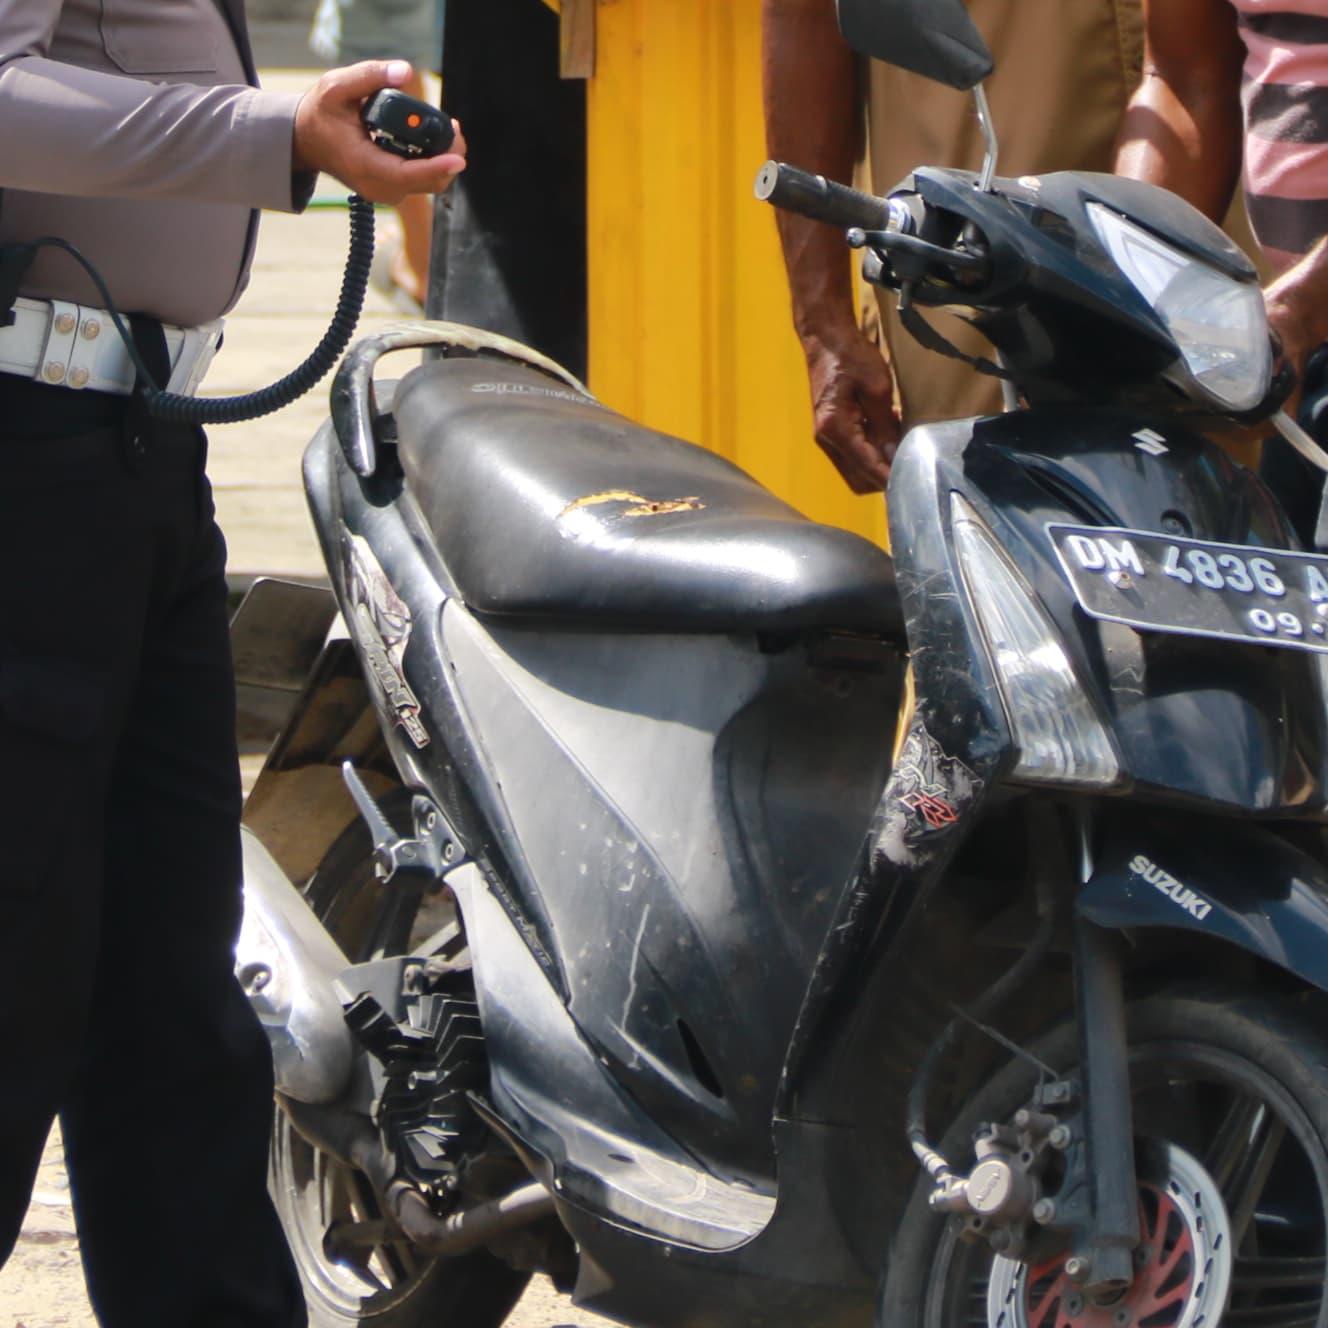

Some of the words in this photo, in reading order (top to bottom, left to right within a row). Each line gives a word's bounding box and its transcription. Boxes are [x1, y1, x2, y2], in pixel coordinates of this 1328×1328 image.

[1066, 534, 1145, 576] DM
[1163, 545, 1286, 598] 4836
[1128, 855, 1213, 921] SUZUKI
